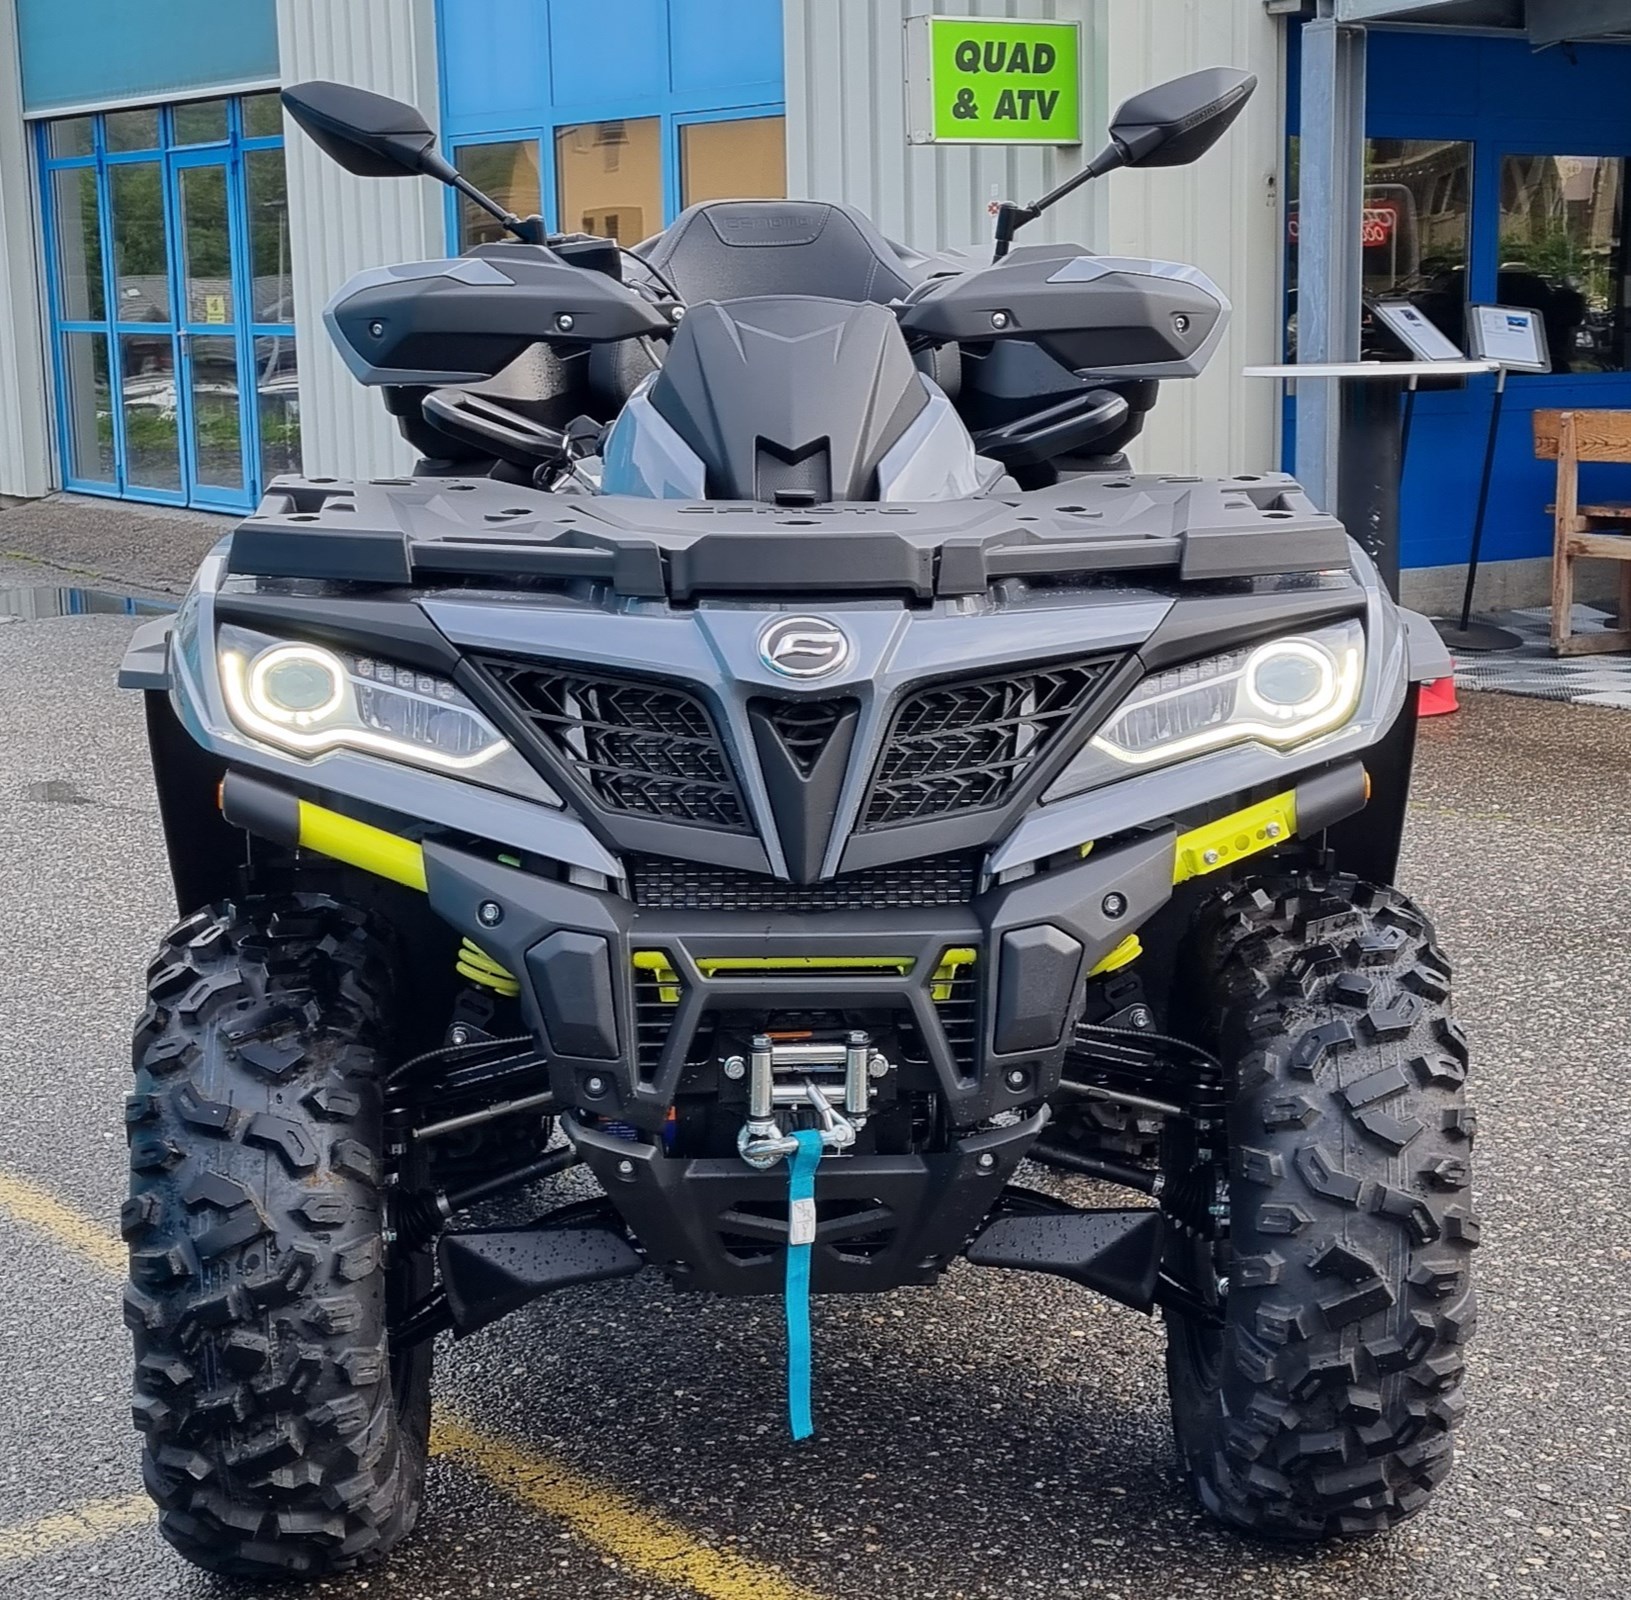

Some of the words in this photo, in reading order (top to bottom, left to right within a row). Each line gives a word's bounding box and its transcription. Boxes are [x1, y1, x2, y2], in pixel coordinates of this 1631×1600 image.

[955, 40, 1056, 74] QUAD
[952, 87, 979, 120] &
[993, 89, 1060, 121] ATV
